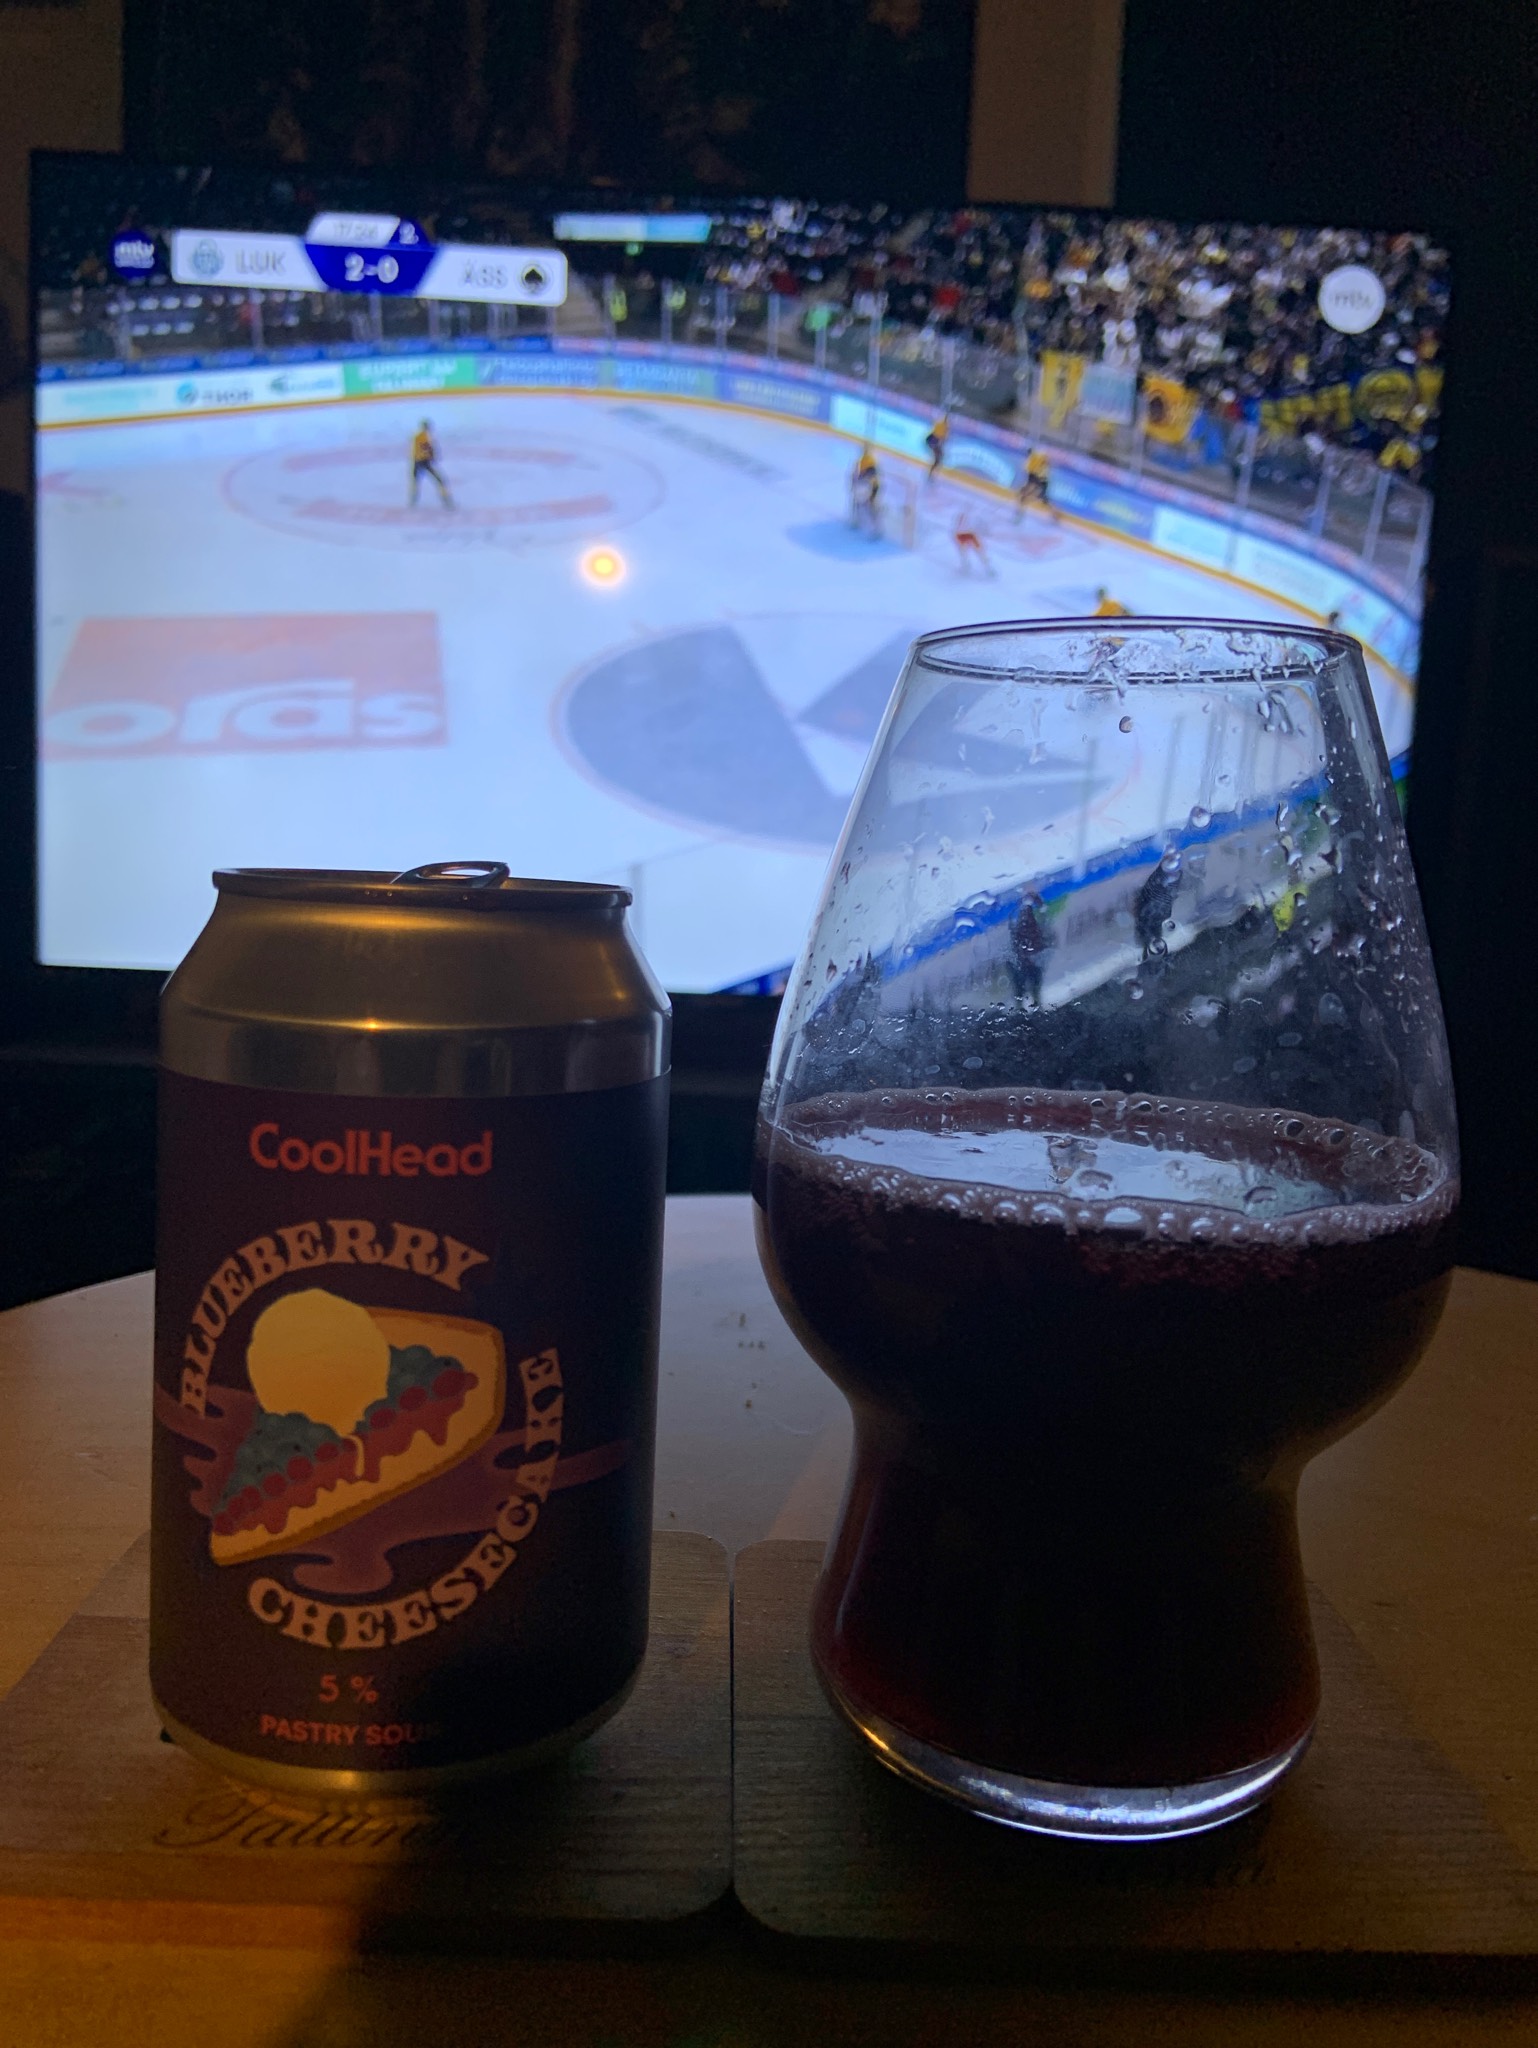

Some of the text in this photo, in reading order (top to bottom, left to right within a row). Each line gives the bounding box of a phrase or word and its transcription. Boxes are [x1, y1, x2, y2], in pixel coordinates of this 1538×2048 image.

[236, 249, 286, 275] LUK
[344, 252, 399, 284] 2-0
[45, 677, 443, 748] oras
[248, 1121, 494, 1178] CoolHead
[180, 1218, 490, 1420] BLUEBERRY
[247, 1346, 565, 1651] CHEESECAKE
[318, 1674, 379, 1703] 5 %
[260, 1713, 360, 1746] PASTRY
